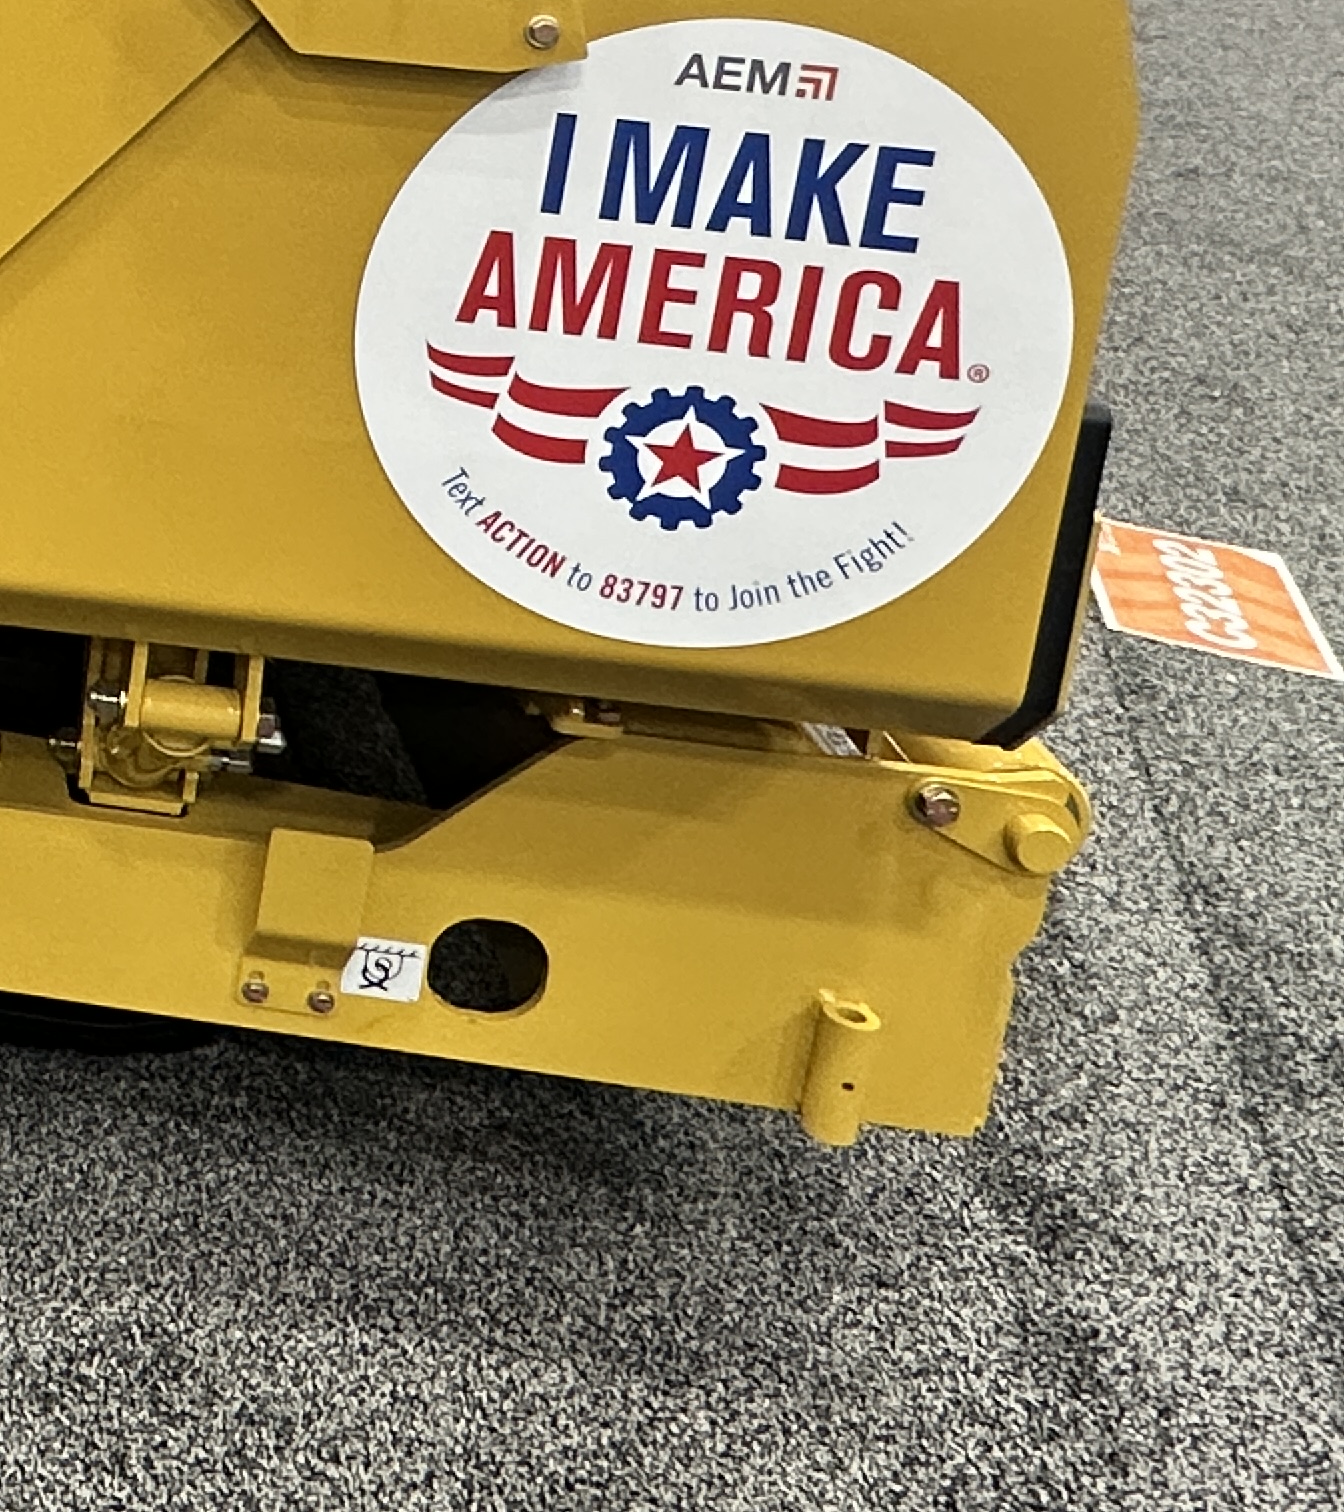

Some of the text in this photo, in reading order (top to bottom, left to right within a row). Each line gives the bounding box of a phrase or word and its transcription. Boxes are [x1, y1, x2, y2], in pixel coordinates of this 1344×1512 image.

[674, 53, 792, 96] AEM
[540, 113, 936, 253] I MAKE
[441, 467, 915, 612] Text ACTION to 83797 to Join the Fight!
[1152, 539, 1258, 649] C32302
